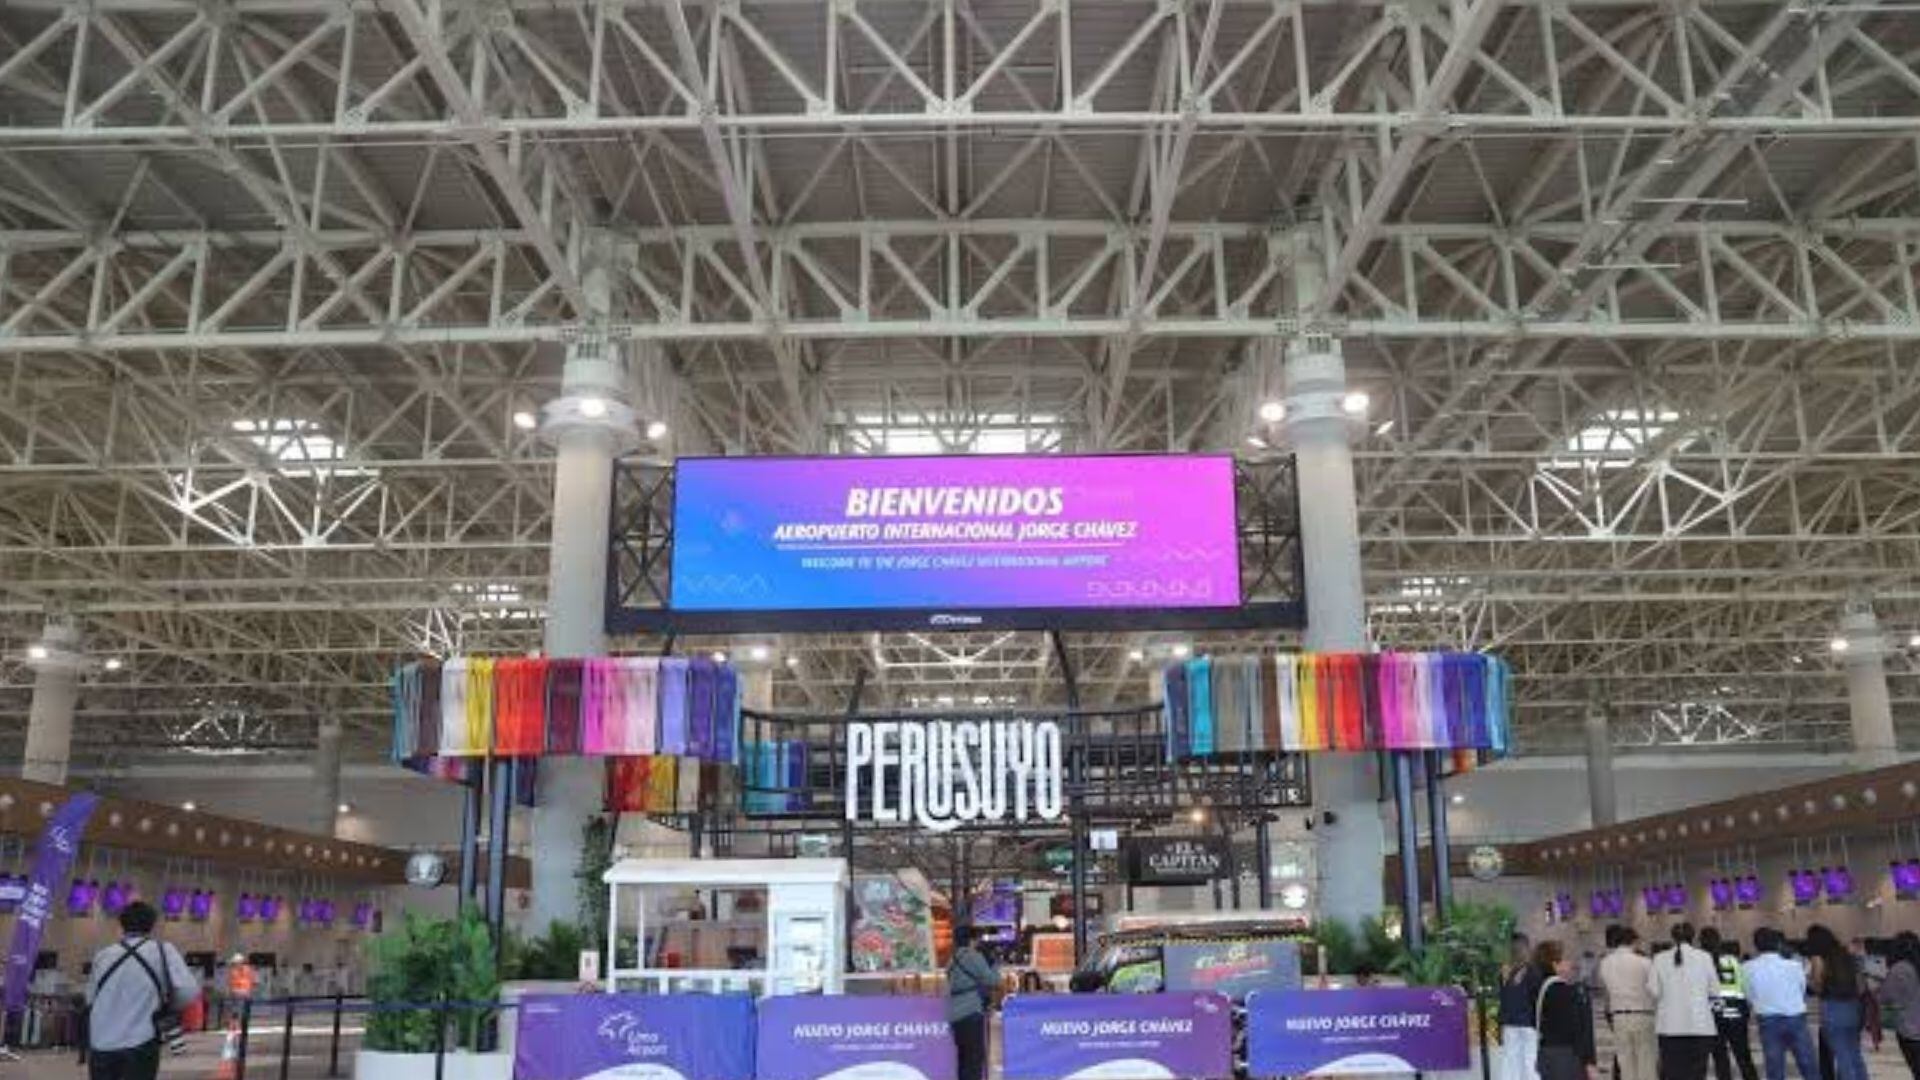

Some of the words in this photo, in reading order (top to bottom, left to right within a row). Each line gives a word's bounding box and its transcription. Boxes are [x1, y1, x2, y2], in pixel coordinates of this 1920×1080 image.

[846, 487, 1064, 517] BIENVENIDOS
[774, 523, 879, 540] AEROPUERTO
[884, 522, 1014, 539] INTERNACIONAL
[1018, 522, 1070, 543] JORGE
[1074, 519, 1138, 538] CHÁVEZ
[845, 719, 1061, 830] PERUSUYO
[793, 1023, 843, 1038] NUEVO
[846, 1022, 891, 1039] JORGE
[1040, 1021, 1090, 1036] NUEVO
[1092, 1019, 1136, 1037] JORGE
[1285, 1017, 1332, 1031] NUEVO
[1335, 1015, 1376, 1032] JORGE
